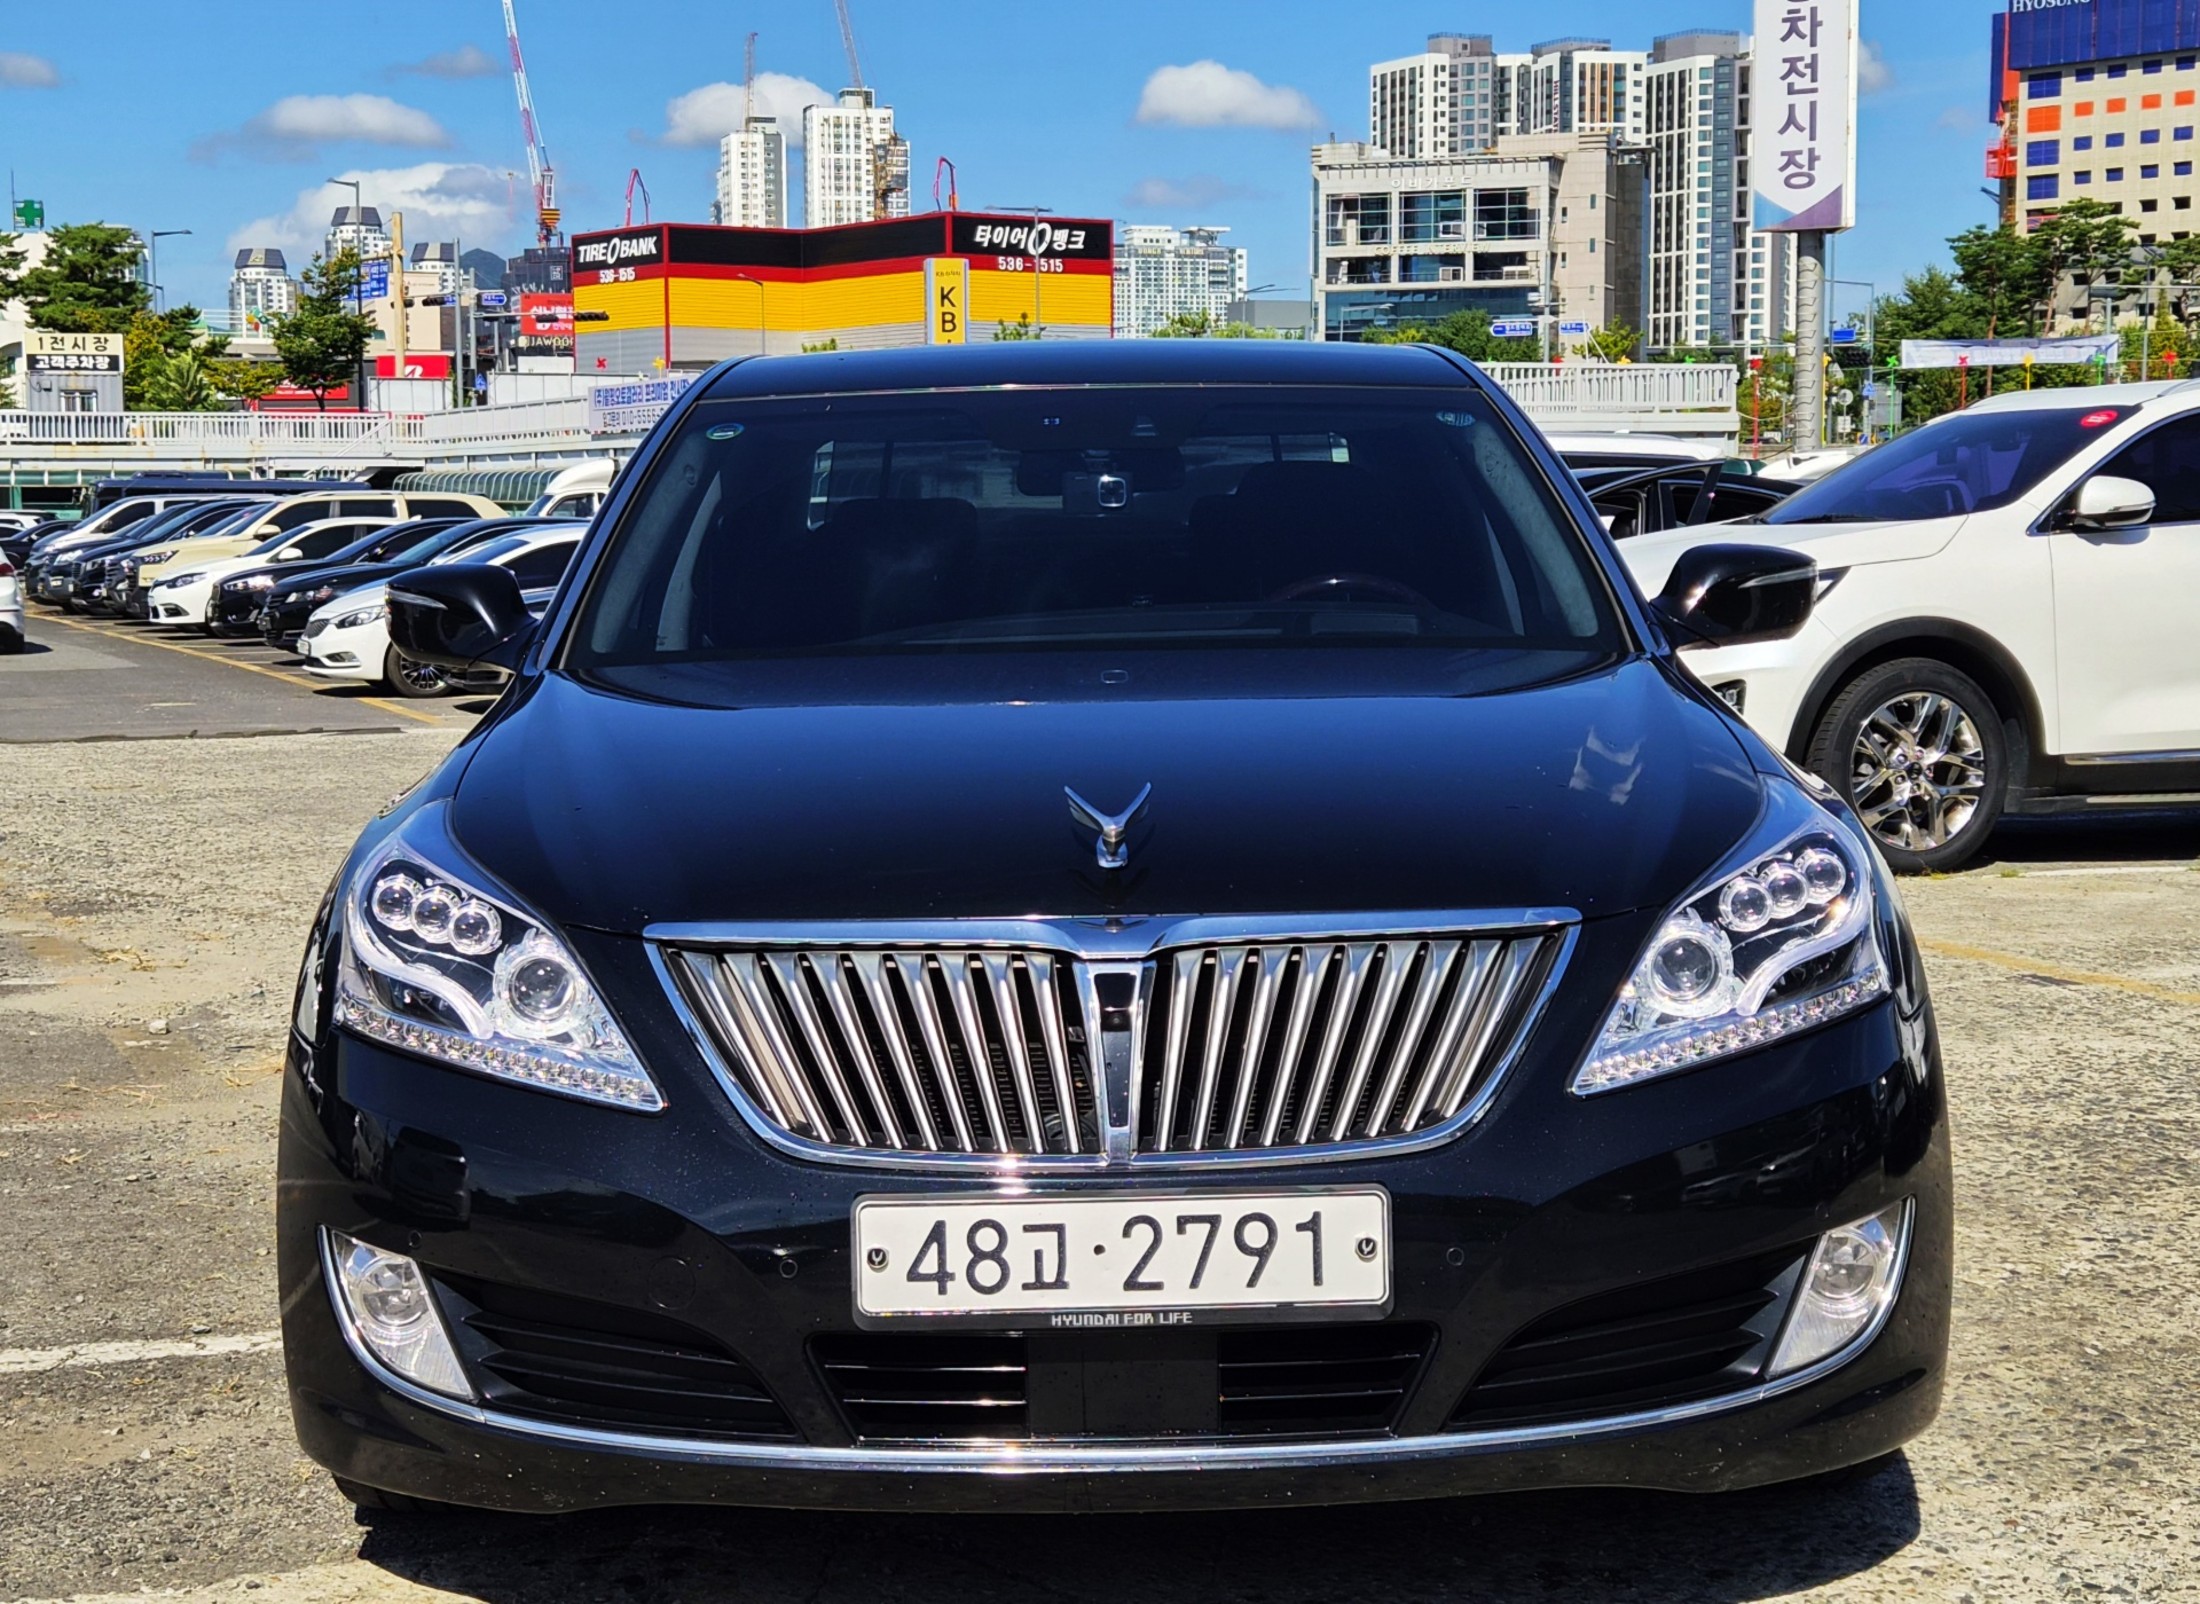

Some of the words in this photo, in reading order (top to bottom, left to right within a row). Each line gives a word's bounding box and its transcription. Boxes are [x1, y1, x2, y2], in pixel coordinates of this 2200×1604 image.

[1778, 0, 1823, 190] 차전시장
[35, 355, 111, 370] 고객주차장
[1121, 1211, 1324, 1292] 2791
[1051, 1313, 1119, 1327] HYUNDAI
[1123, 1312, 1154, 1325] FOR
[1159, 1311, 1193, 1325] LIFE
